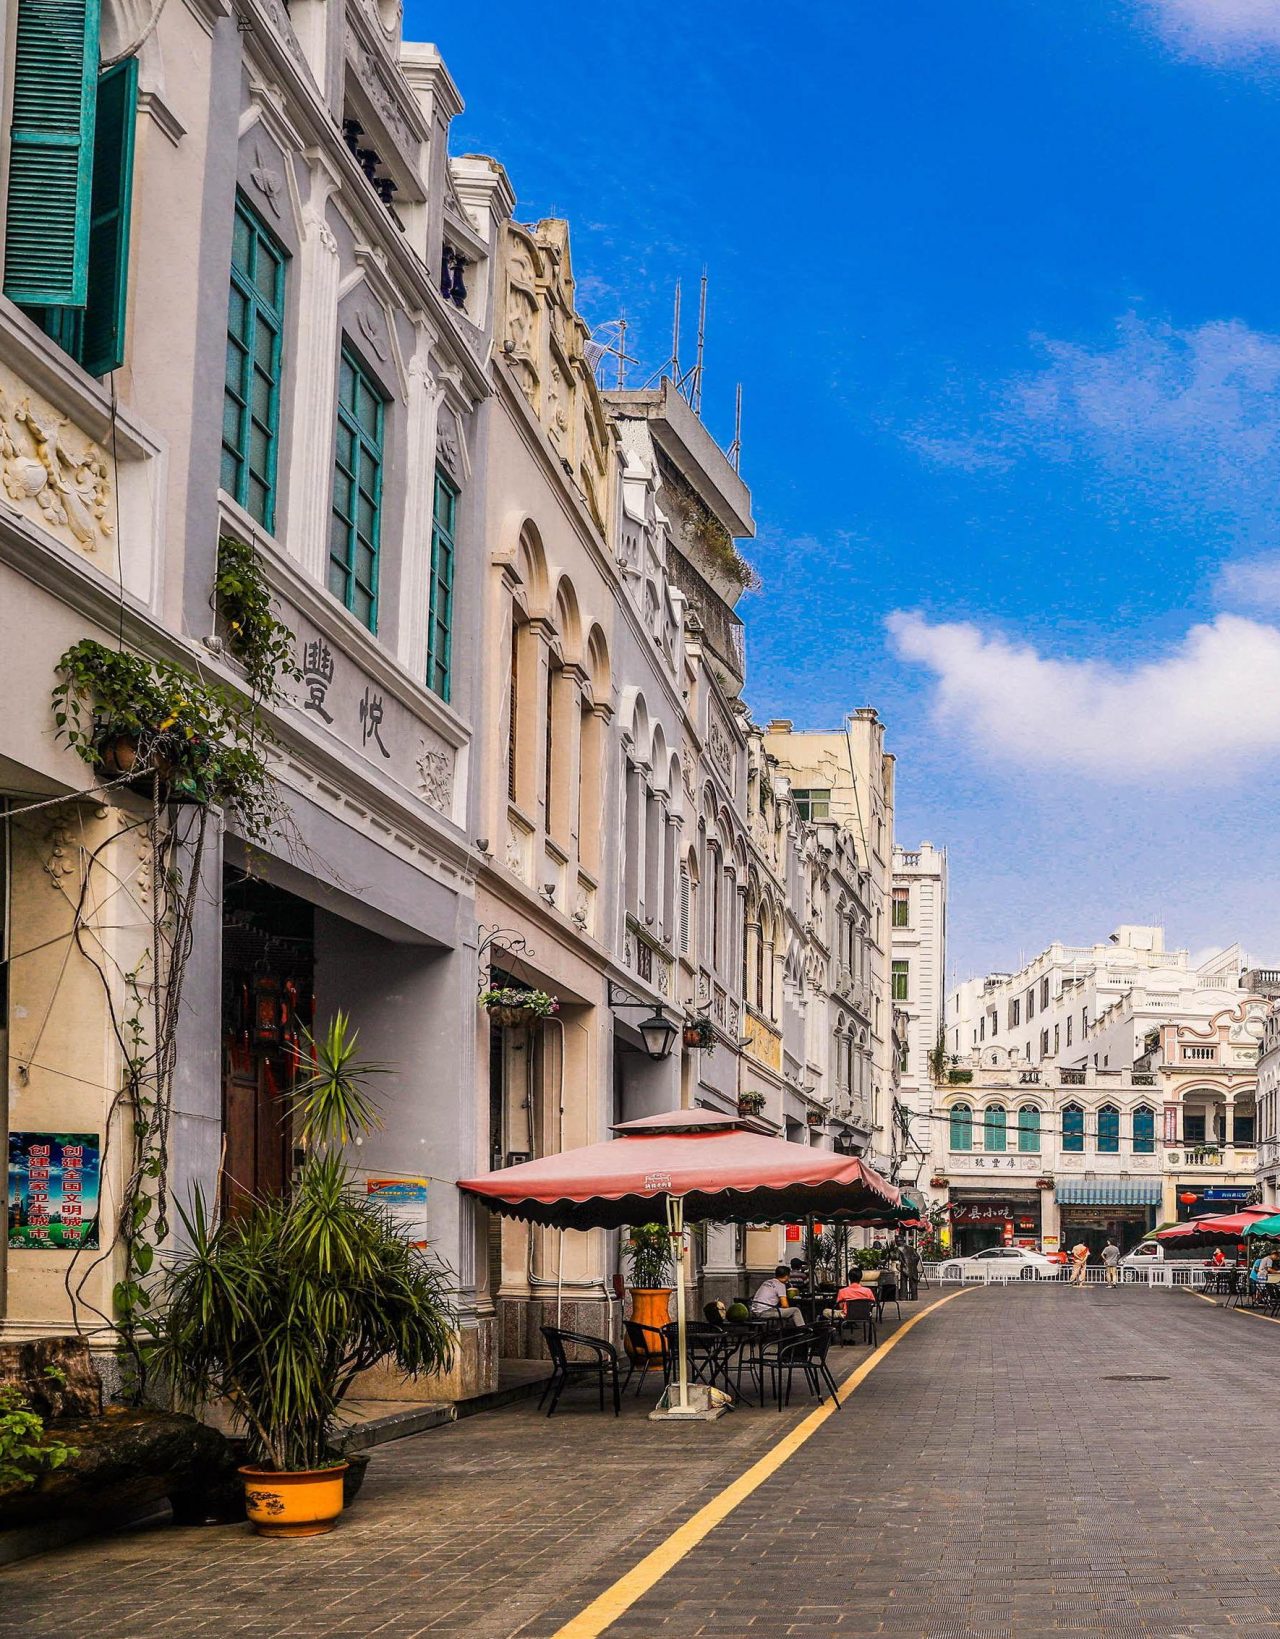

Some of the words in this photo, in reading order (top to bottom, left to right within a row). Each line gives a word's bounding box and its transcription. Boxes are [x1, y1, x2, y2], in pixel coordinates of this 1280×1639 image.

[28, 1144, 50, 1239] 创建国家卫生城市
[61, 1144, 83, 1240] 创建全国文明城市
[953, 1204, 1013, 1219] 沙县小吃
